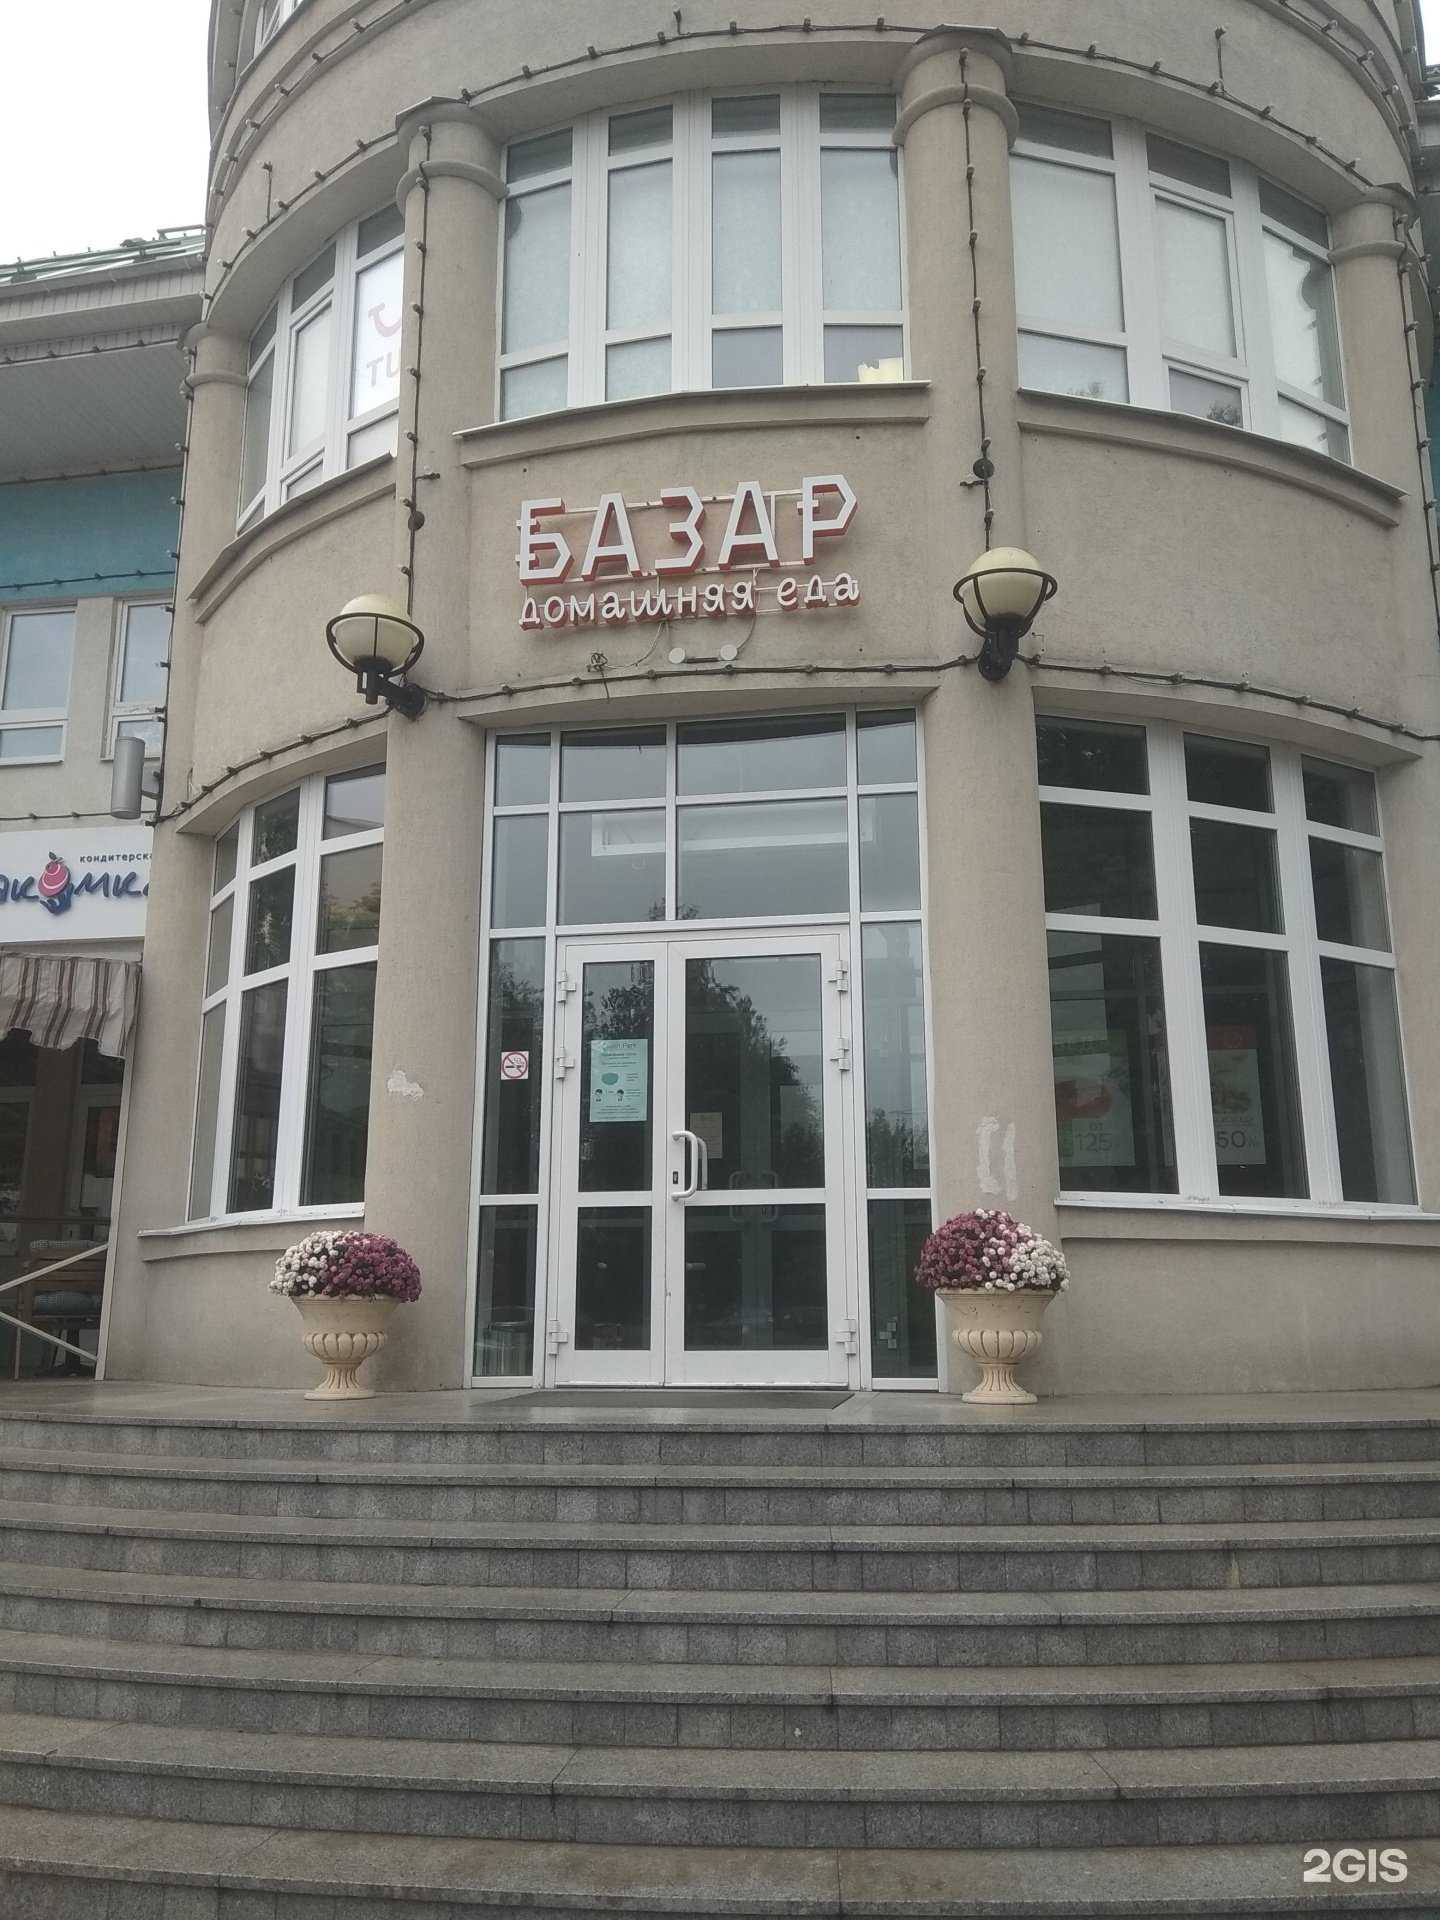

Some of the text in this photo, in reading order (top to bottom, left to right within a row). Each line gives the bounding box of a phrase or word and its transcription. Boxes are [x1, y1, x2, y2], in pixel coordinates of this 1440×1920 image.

[515, 474, 858, 585] БАЗАР
[518, 572, 861, 630] домашняя еда
